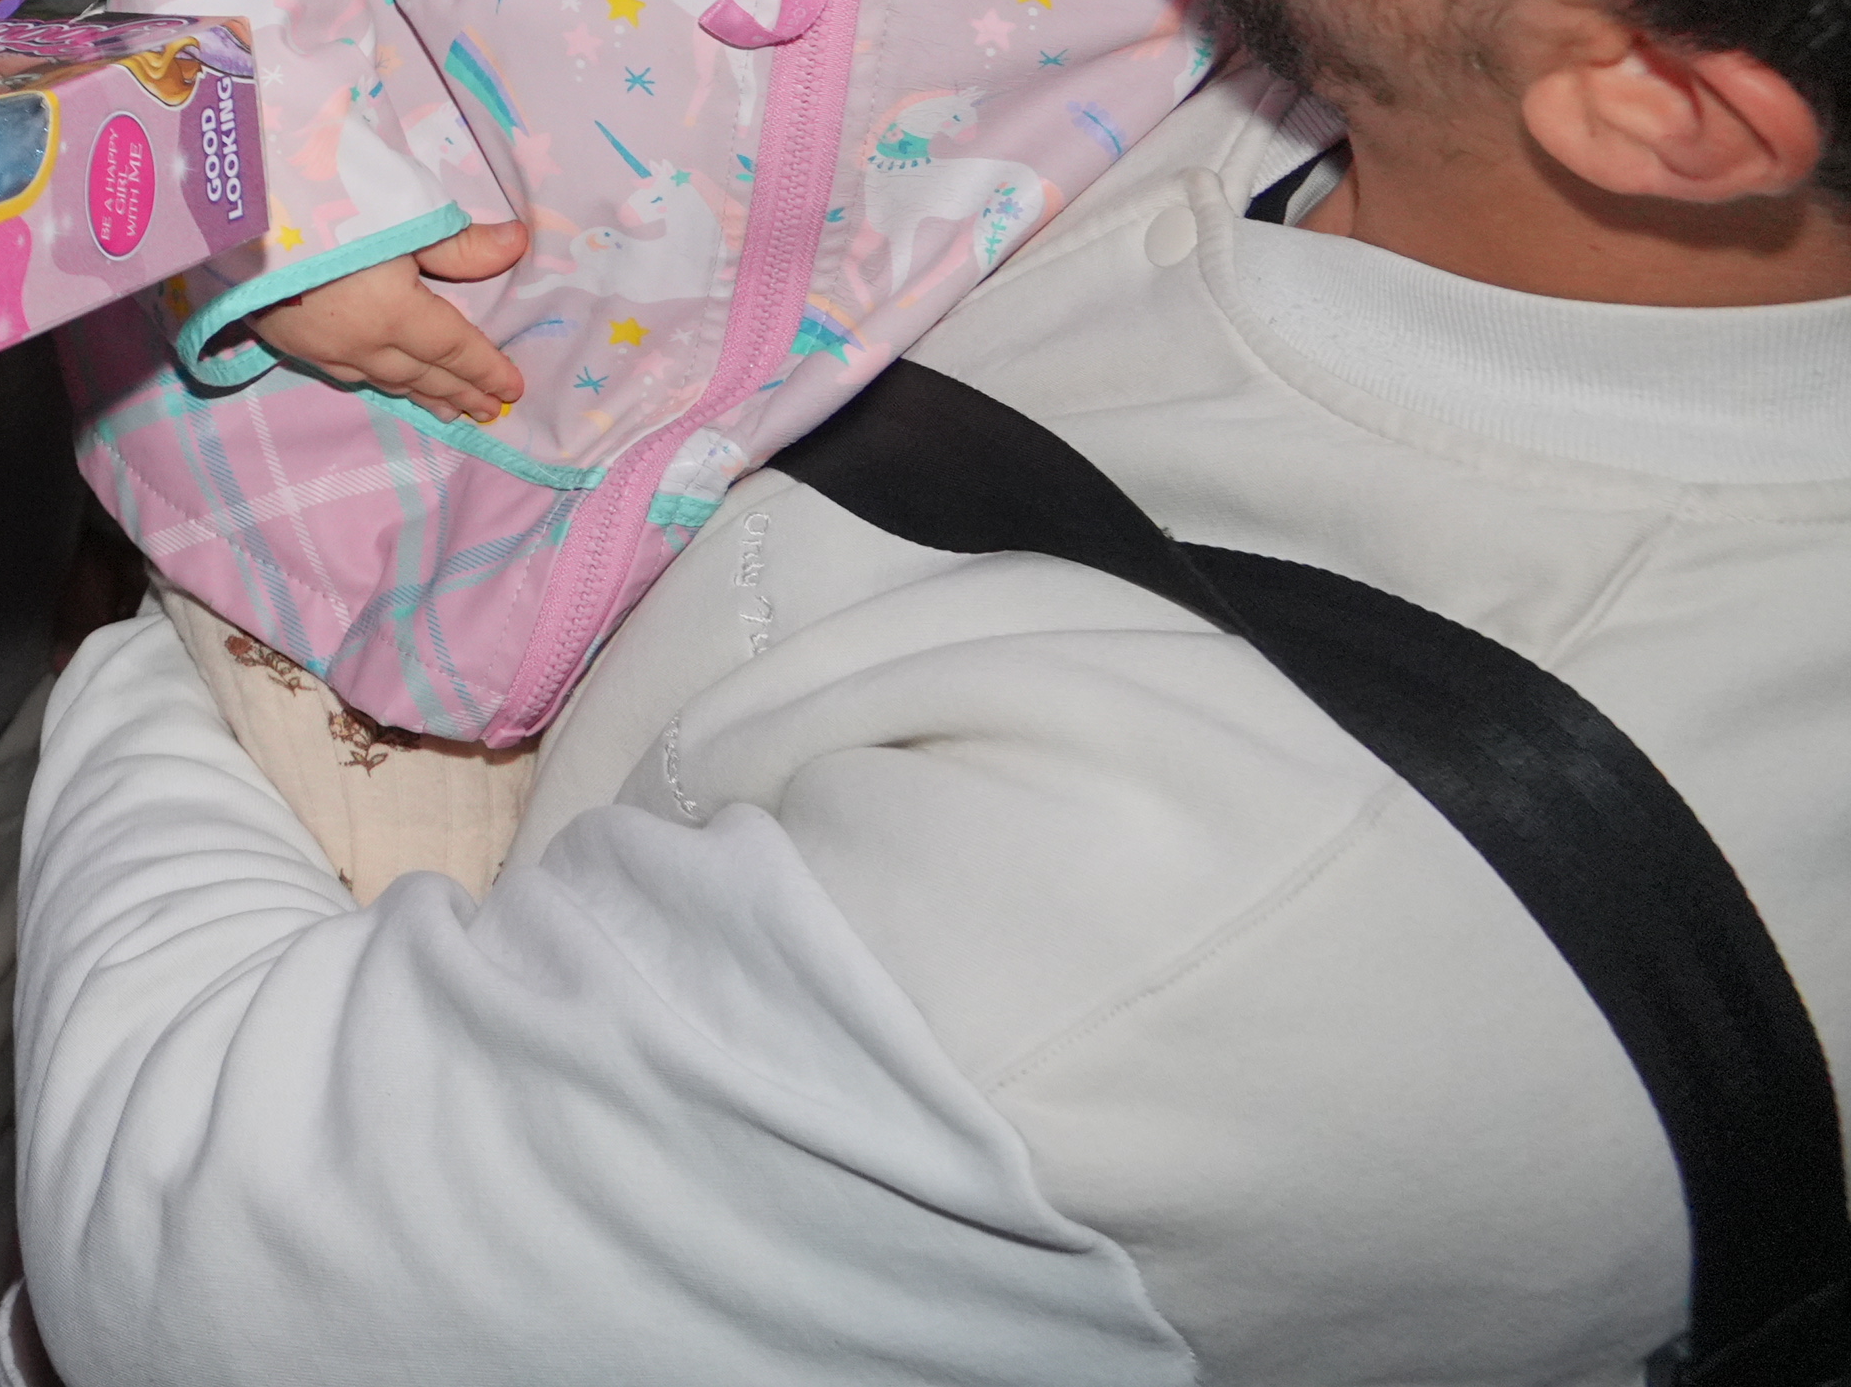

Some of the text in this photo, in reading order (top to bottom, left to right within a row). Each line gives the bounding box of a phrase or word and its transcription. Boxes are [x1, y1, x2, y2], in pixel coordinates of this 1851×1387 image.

[101, 128, 119, 241] BE A HAPPY
[115, 164, 131, 216] GIRL
[126, 142, 143, 238] WITH ME
[201, 107, 223, 202] GOOD
[216, 77, 244, 222] LOOKING
